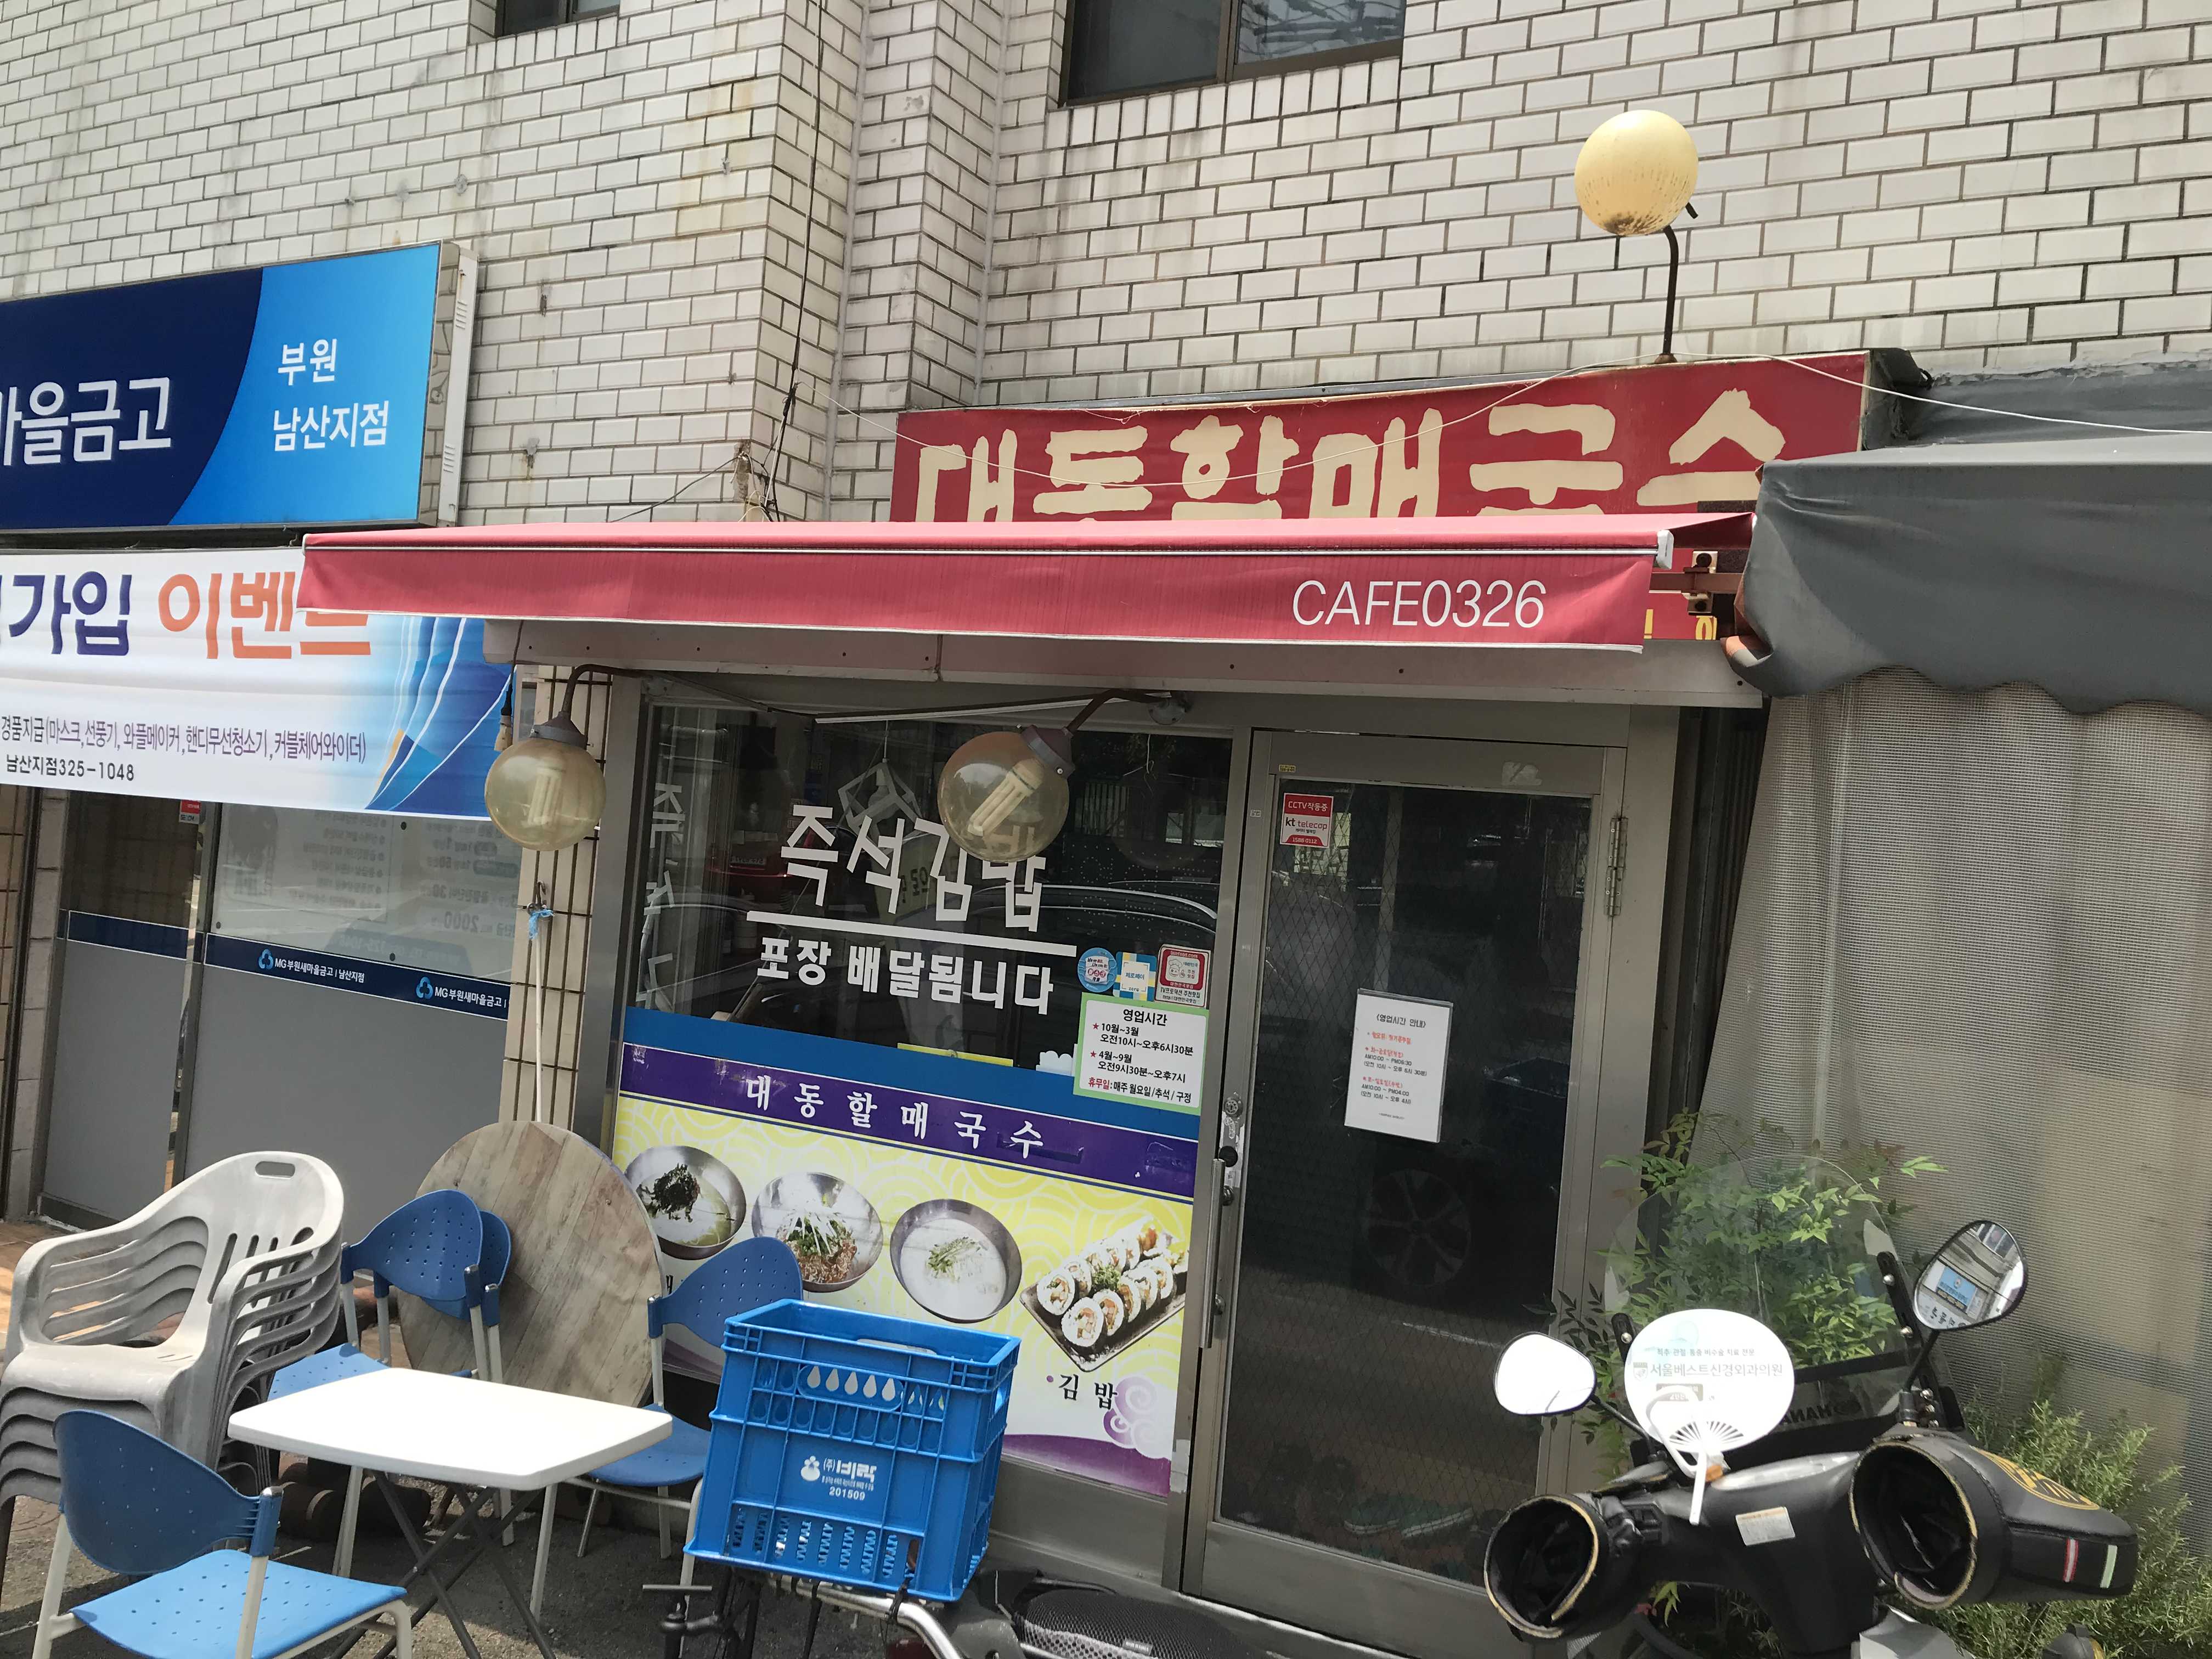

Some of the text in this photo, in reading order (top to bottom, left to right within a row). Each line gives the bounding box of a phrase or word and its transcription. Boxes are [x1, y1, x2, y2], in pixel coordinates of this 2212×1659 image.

[278, 338, 337, 385] 부원
[273, 400, 388, 452] 남산지점
[0, 571, 132, 656] 가입
[1293, 580, 1547, 628] CAFE0326
[1285, 817, 1296, 827] kt
[781, 804, 1046, 932] 즉석김밥
[757, 937, 832, 986] 포장
[1101, 1023, 1139, 1036] 10월~3월
[1123, 1009, 1167, 1026] 영업시간
[1098, 1051, 1132, 1063] 4월~9월
[829, 1486, 866, 1501] 201509
